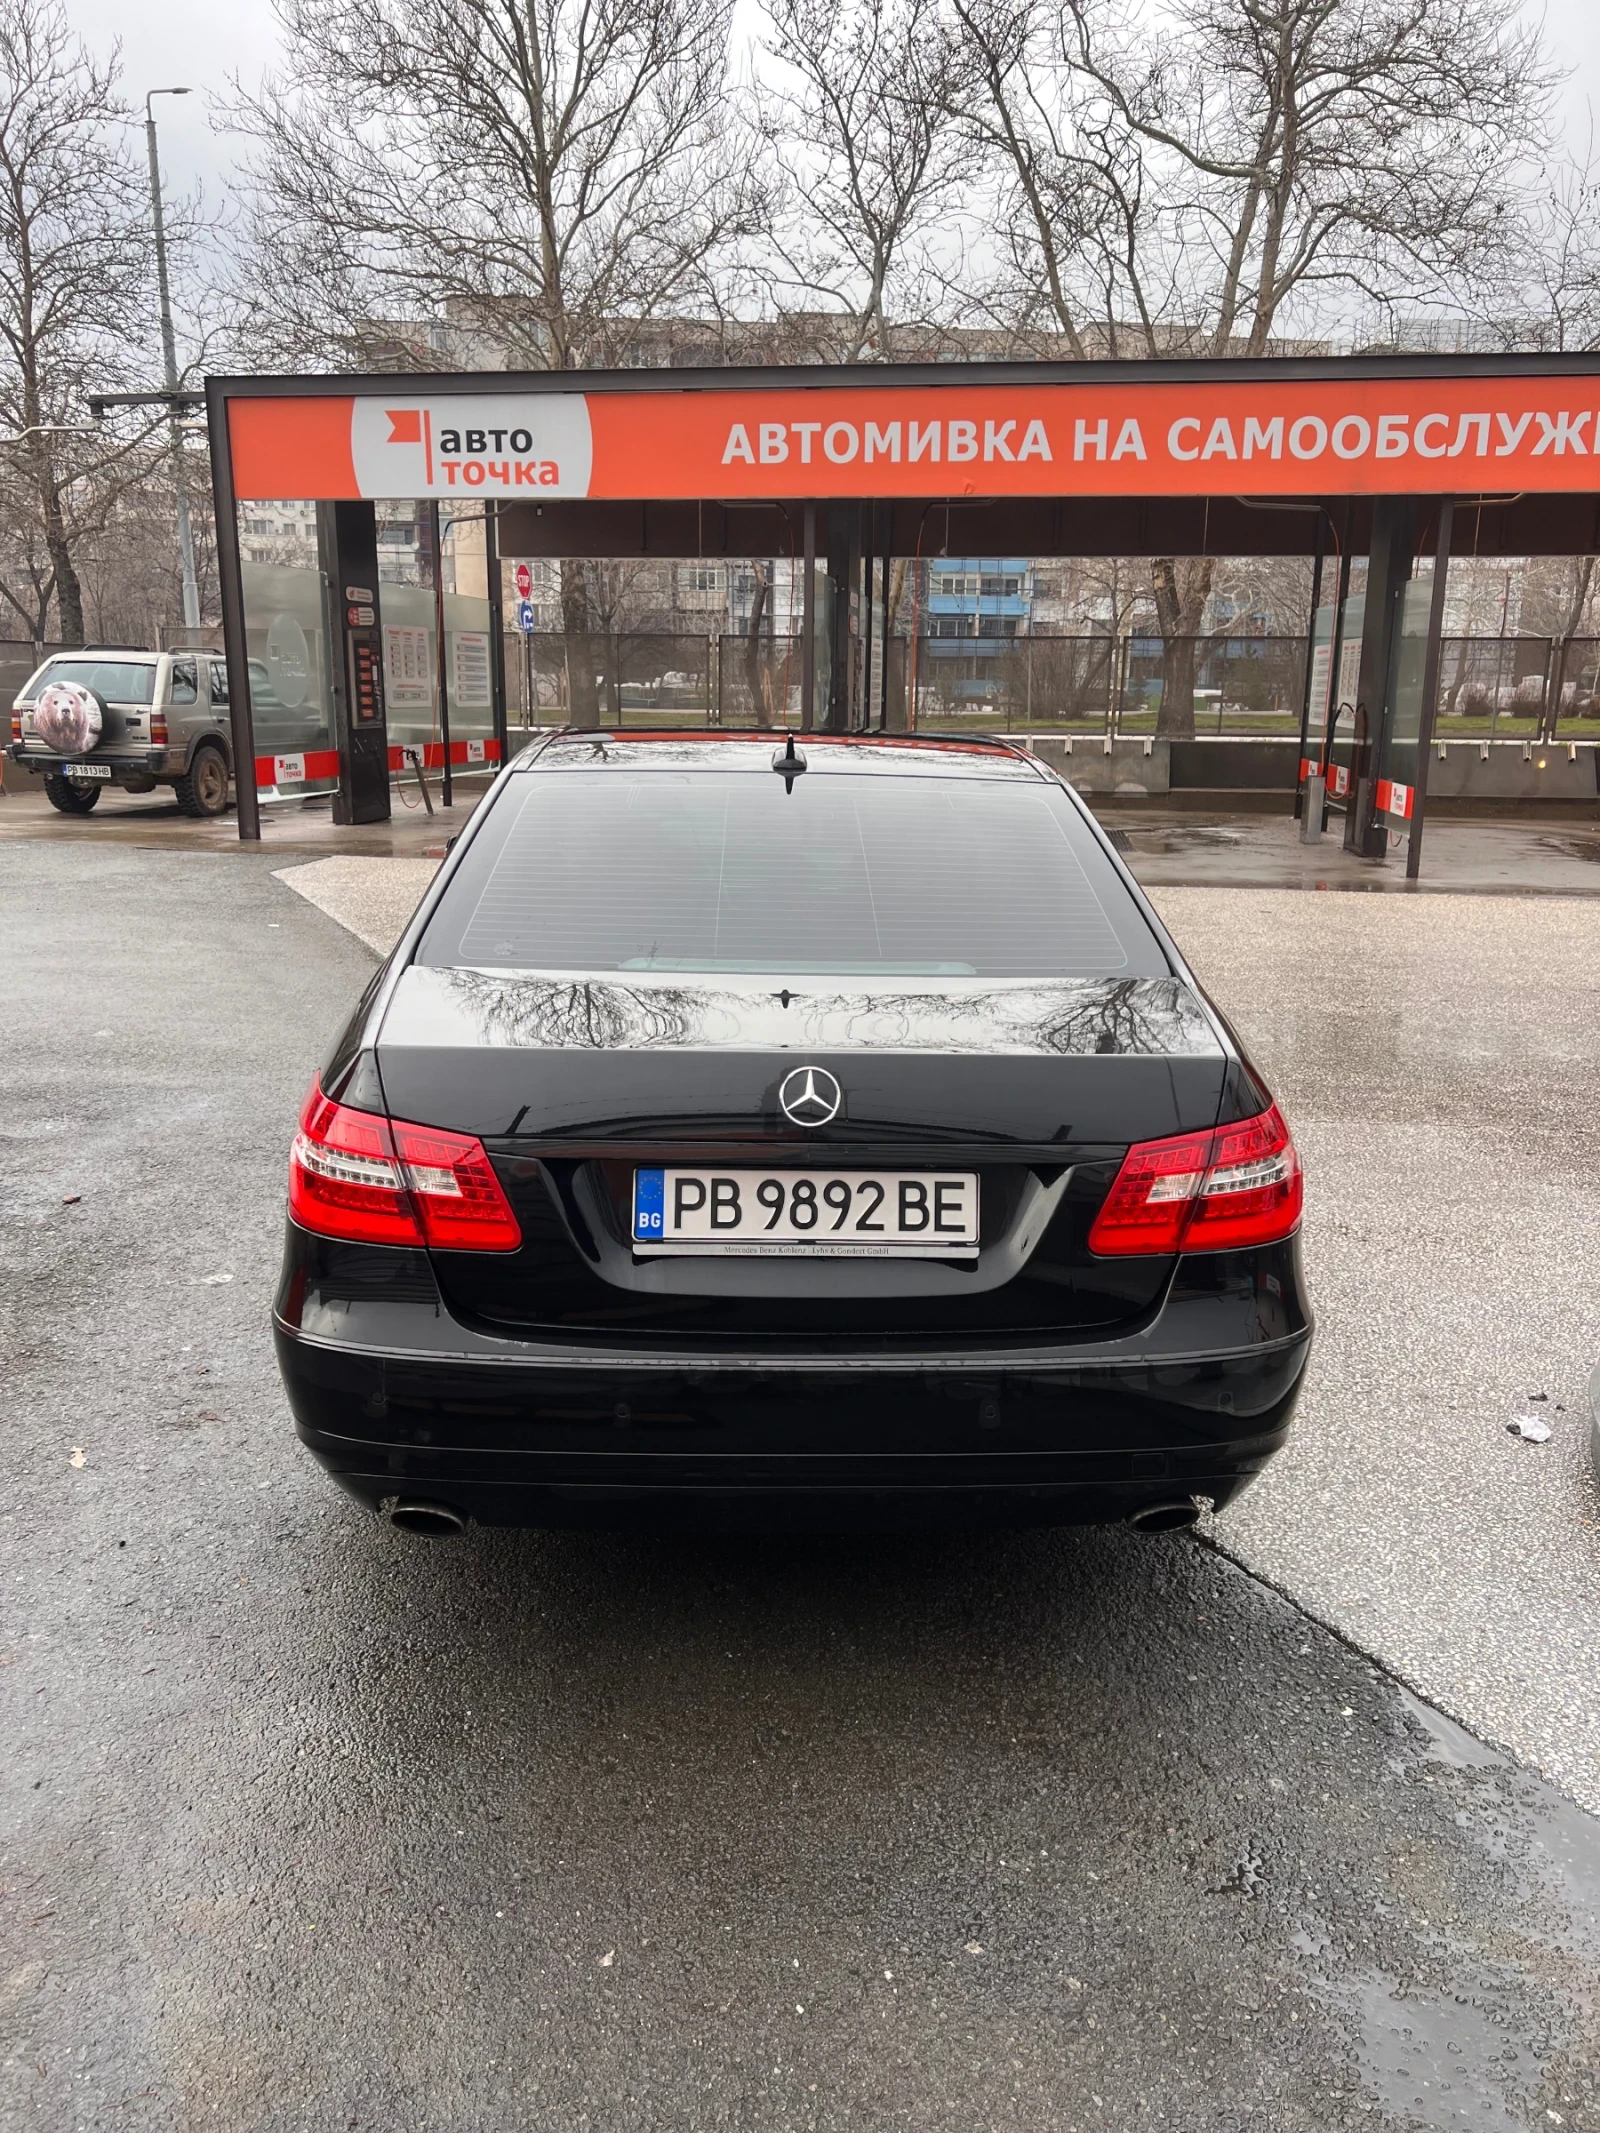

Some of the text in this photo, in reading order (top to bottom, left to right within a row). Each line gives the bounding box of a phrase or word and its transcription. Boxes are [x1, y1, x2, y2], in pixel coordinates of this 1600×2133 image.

[440, 428, 533, 454] авто
[721, 410, 1600, 465] АВТОМИВКА НА САМООБСЛУЖ
[441, 460, 559, 486] точка
[517, 574, 530, 588] STOP
[79, 766, 98, 776] 1813
[99, 767, 110, 776] HB
[285, 762, 298, 771] авто
[673, 1177, 967, 1233] PB 9892 BE
[638, 1212, 662, 1229] BG
[724, 1246, 757, 1254] Mercedes
[759, 1246, 776, 1254] Benz
[778, 1246, 806, 1254] Koblenz
[829, 1247, 836, 1255] &
[867, 1247, 889, 1255] GmbH
